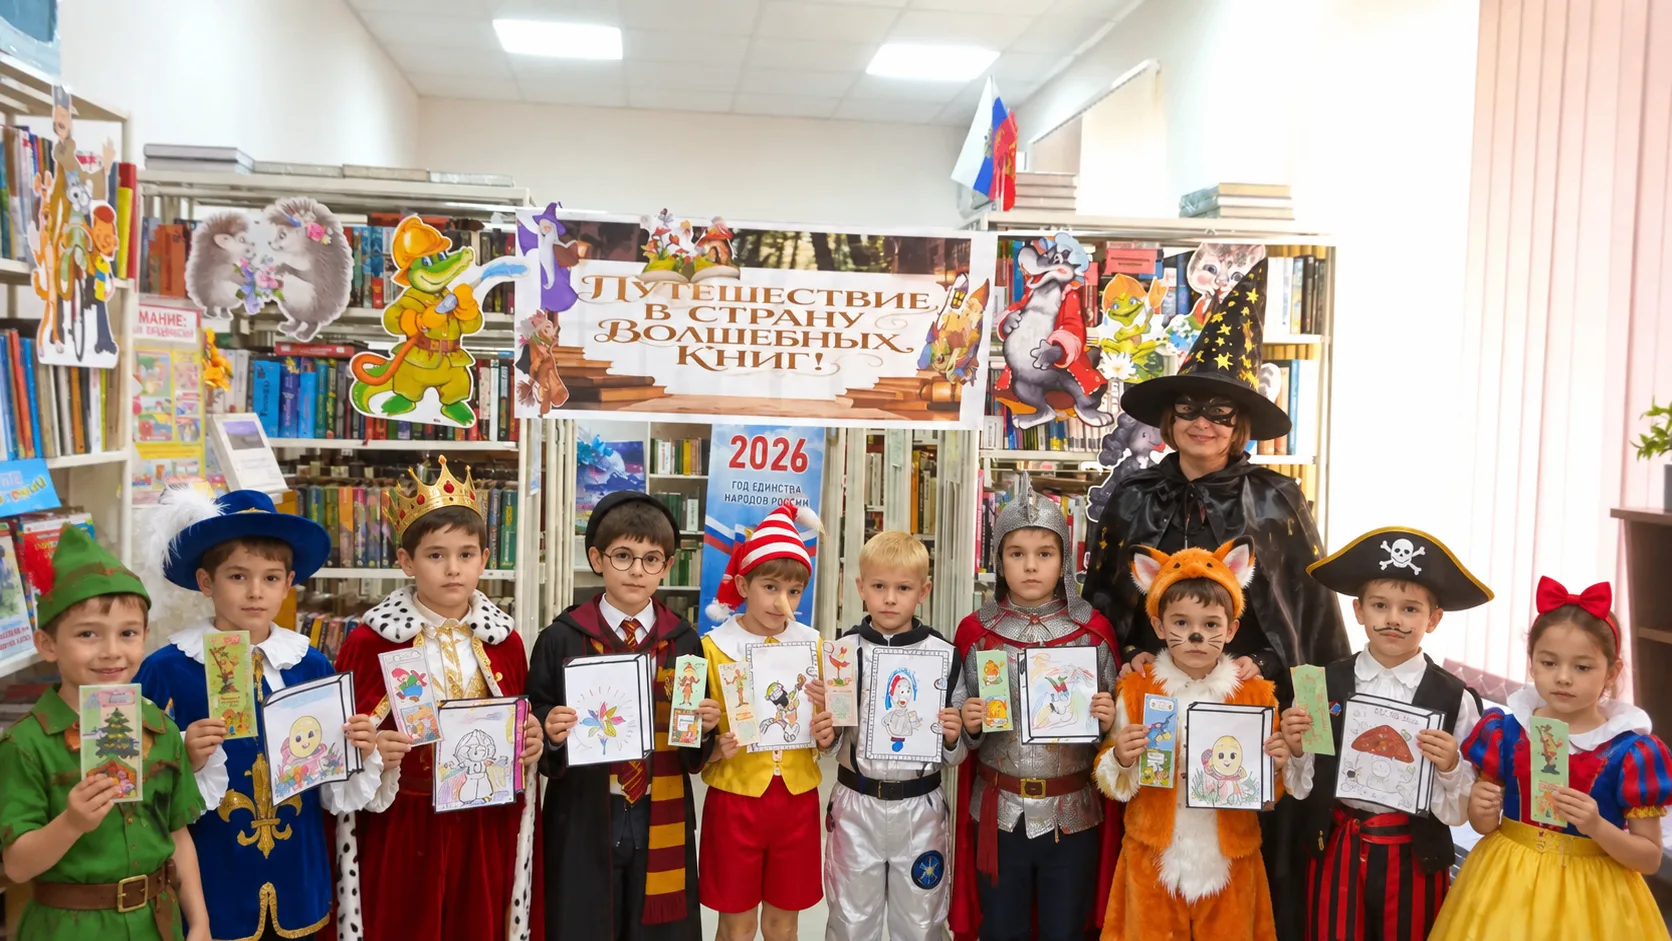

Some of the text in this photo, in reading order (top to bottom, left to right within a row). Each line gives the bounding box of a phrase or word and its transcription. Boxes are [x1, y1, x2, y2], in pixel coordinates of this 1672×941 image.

[579, 274, 931, 310] ПУТЕШЕСТВИЕ
[139, 310, 187, 328] МАНИЕ:
[644, 303, 865, 329] В СТРАНУ
[593, 318, 914, 353] ВОЛШЕБНЫХ
[676, 345, 824, 372] КНИГ!
[728, 434, 809, 474] 2026
[724, 493, 769, 506] НАРОДОВ
[732, 480, 802, 495] ГОД ЕДИНСТВА
